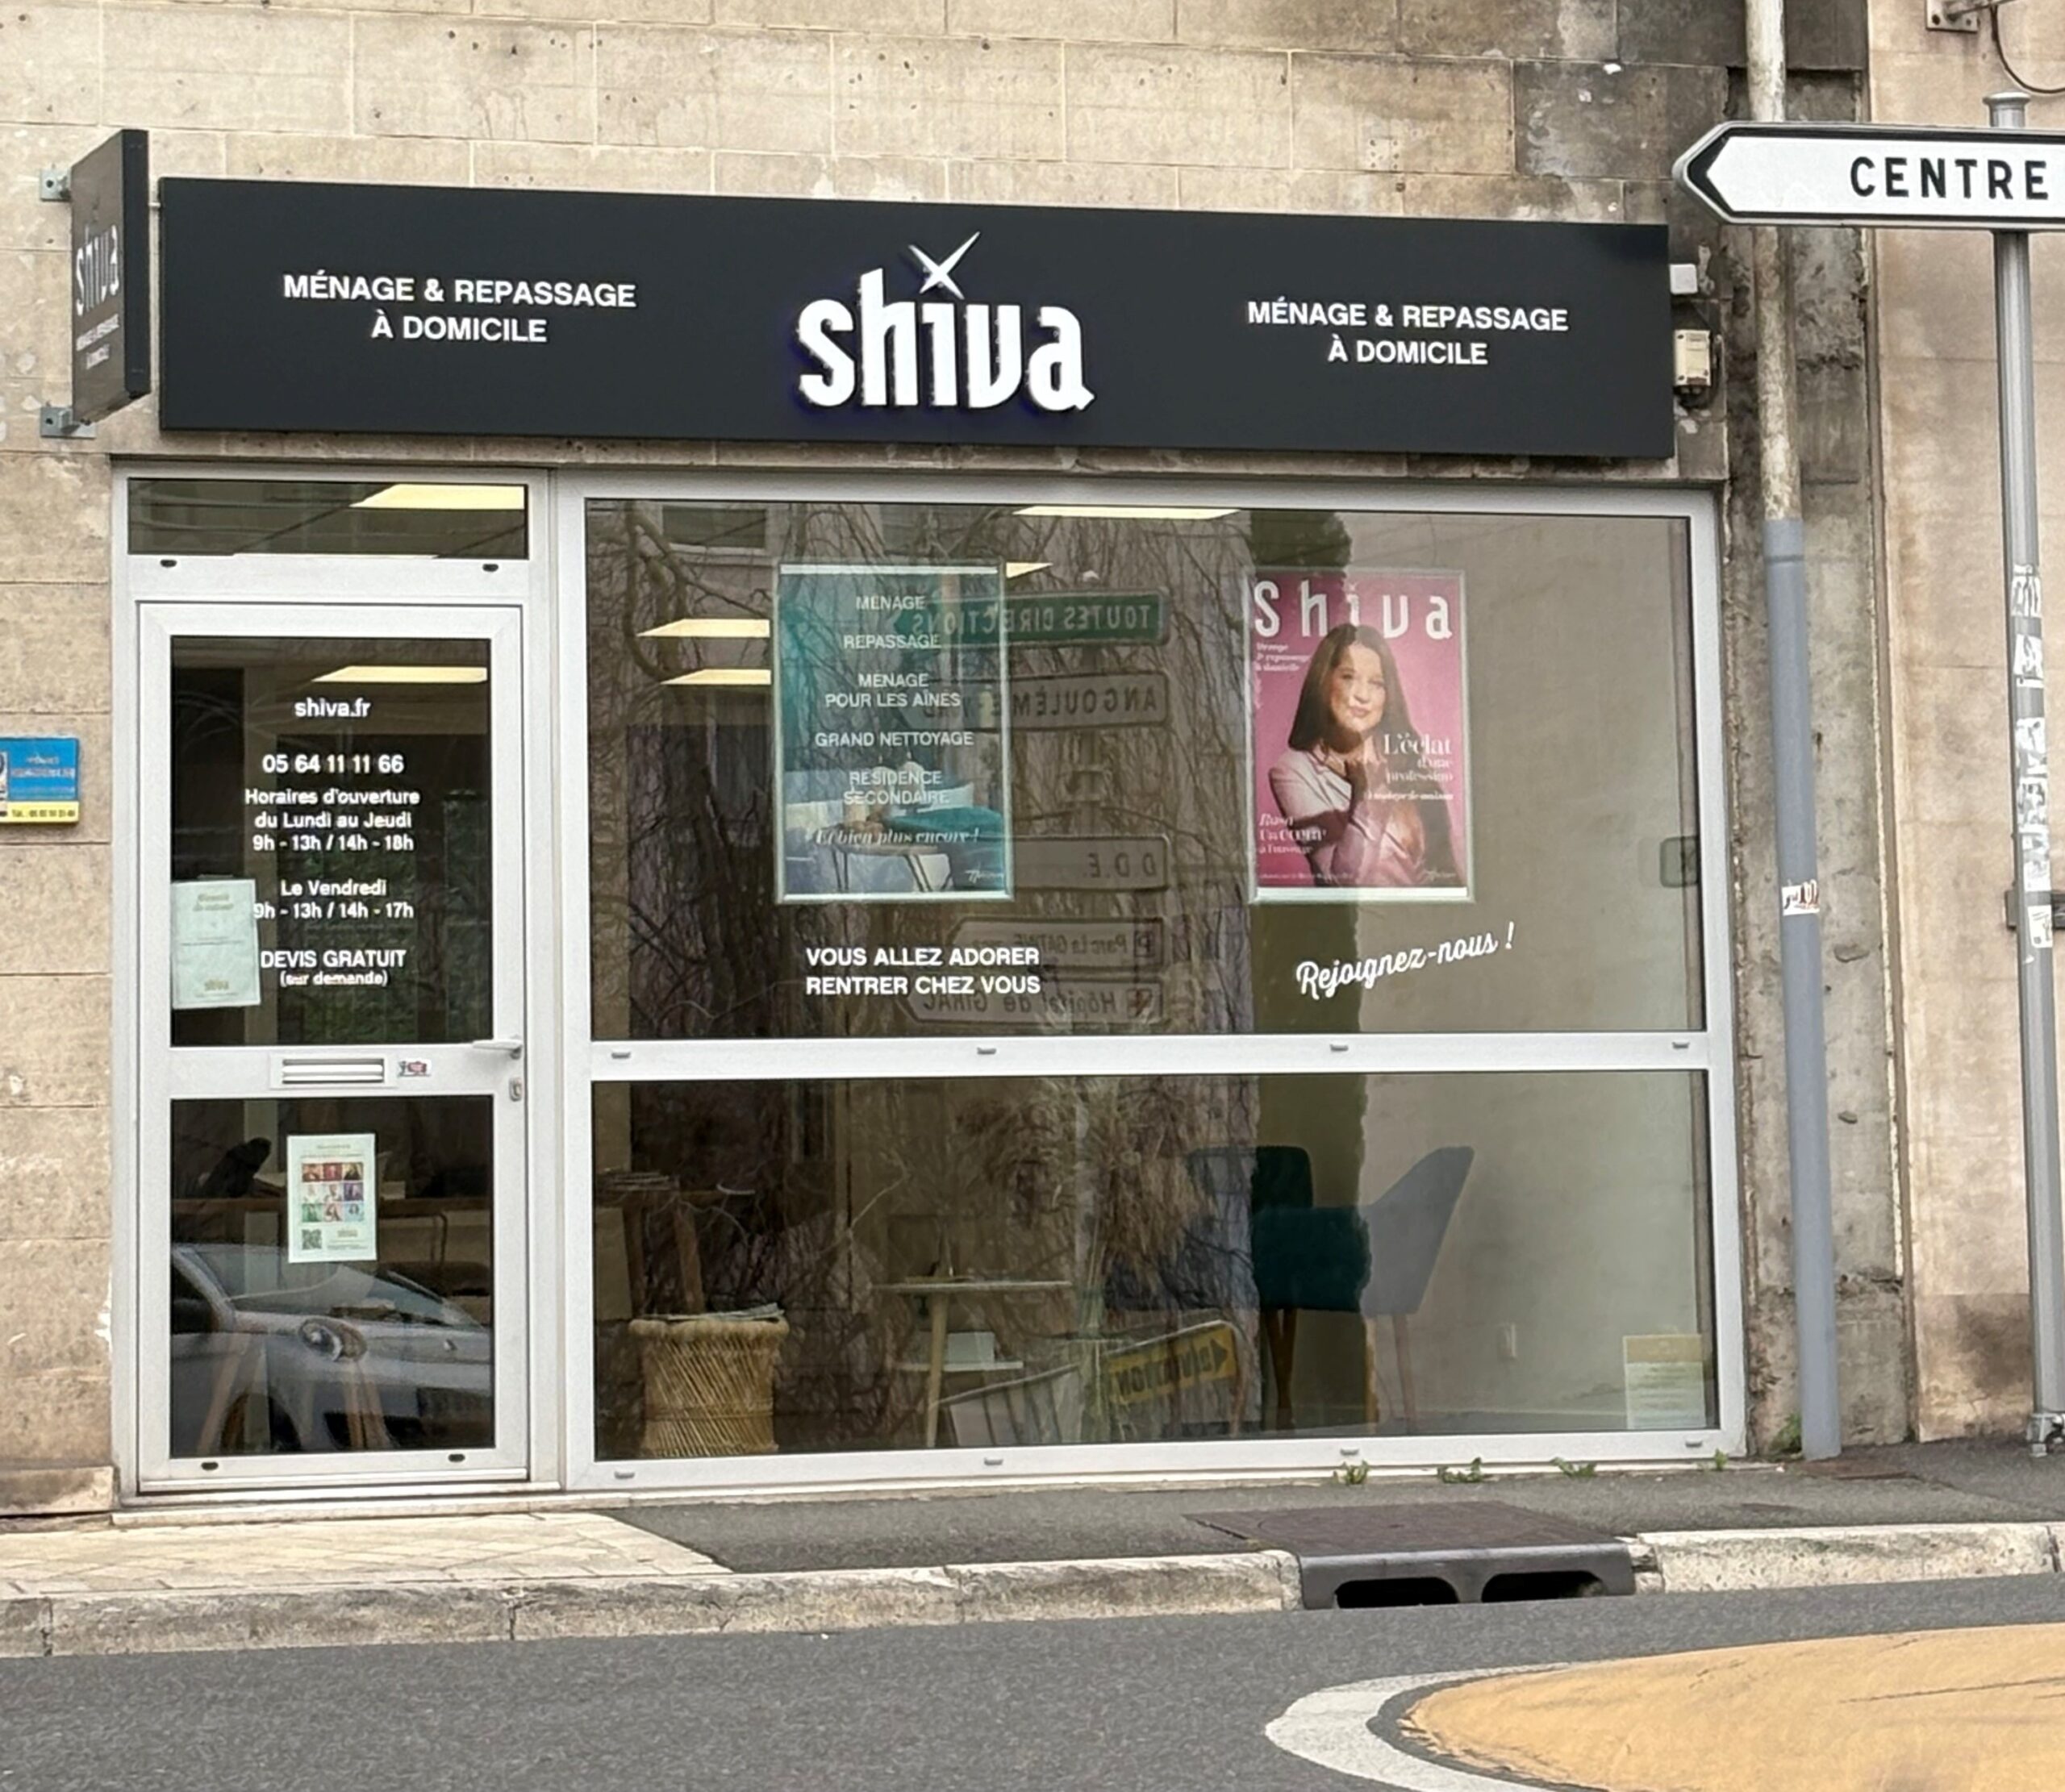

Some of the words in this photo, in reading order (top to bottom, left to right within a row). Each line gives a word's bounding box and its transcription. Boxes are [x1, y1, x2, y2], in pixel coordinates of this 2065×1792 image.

[1850, 156, 2049, 200] CENTRE
[283, 270, 415, 302] MÉNAGE
[423, 278, 445, 302] &
[454, 280, 637, 307] REPASSAGE
[796, 231, 1095, 410] shiva
[1247, 296, 1368, 327] MÉNAGE
[1375, 304, 1394, 327] &
[1402, 306, 1569, 331] REPASSAGE
[370, 309, 394, 338] À
[403, 315, 548, 343] DOMICILE
[1327, 334, 1349, 362] À
[1357, 340, 1488, 365] DOMICILE
[843, 634, 942, 649] REPASSAGE
[294, 697, 372, 718] shiva.fr
[825, 693, 872, 708] POUR
[877, 693, 908, 707] LES
[815, 731, 874, 747] GRAND
[880, 731, 975, 746] NETTOYAGE
[262, 754, 289, 773] 05
[294, 755, 321, 773] 64
[327, 755, 345, 773] 11
[352, 755, 371, 773] 11
[378, 754, 404, 773] 66
[244, 789, 318, 805] Horaires
[323, 787, 419, 805] d'ouverture
[844, 790, 950, 805] SECONDAIRE
[254, 812, 277, 828] du
[282, 811, 332, 828] Lundi
[336, 816, 358, 829] au
[363, 811, 412, 828] Jeudi
[252, 835, 275, 852] 9h
[293, 834, 321, 851] 13h
[325, 834, 333, 851] /
[338, 834, 368, 851] 14h
[386, 834, 414, 852] 18h
[281, 880, 303, 897] Le
[307, 878, 387, 897] Vendredi
[252, 902, 275, 919] 9h
[293, 902, 322, 919] 13h
[326, 902, 333, 919] /
[340, 901, 369, 919] 14h
[386, 901, 414, 919] 17h
[260, 950, 317, 968] DEVIS
[323, 949, 407, 968] GRATUIT
[807, 947, 867, 967] VOUS
[874, 947, 943, 966] ALLEZ
[949, 947, 1040, 966] ADORER
[1295, 932, 1499, 1000] Rejoignez-nous
[1504, 921, 1514, 950] !
[807, 976, 908, 995] RENTRER
[915, 976, 975, 994] CHEZ
[982, 975, 1041, 994] VOUS
